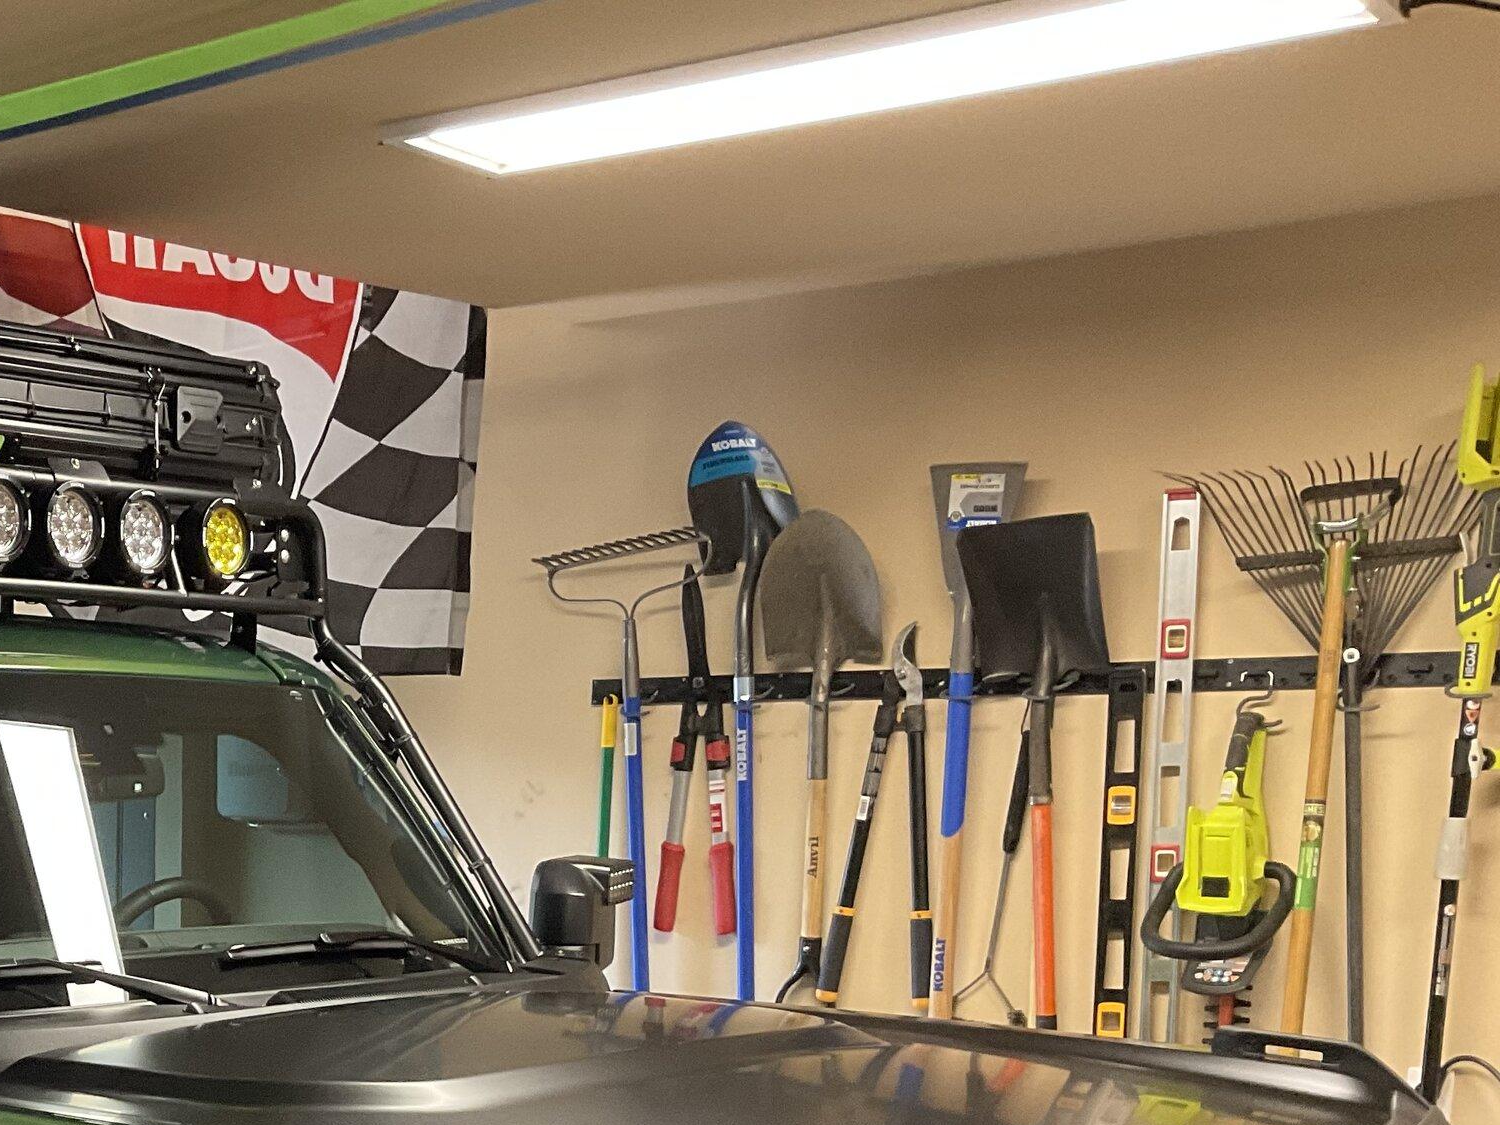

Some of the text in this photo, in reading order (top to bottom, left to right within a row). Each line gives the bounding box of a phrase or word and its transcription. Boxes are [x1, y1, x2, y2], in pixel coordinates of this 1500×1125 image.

[711, 438, 757, 452] KOBALT
[1463, 644, 1477, 677] RYOBI
[736, 728, 748, 782] KOBALT
[806, 835, 820, 879] Anvil
[932, 937, 947, 992] KOBALT
